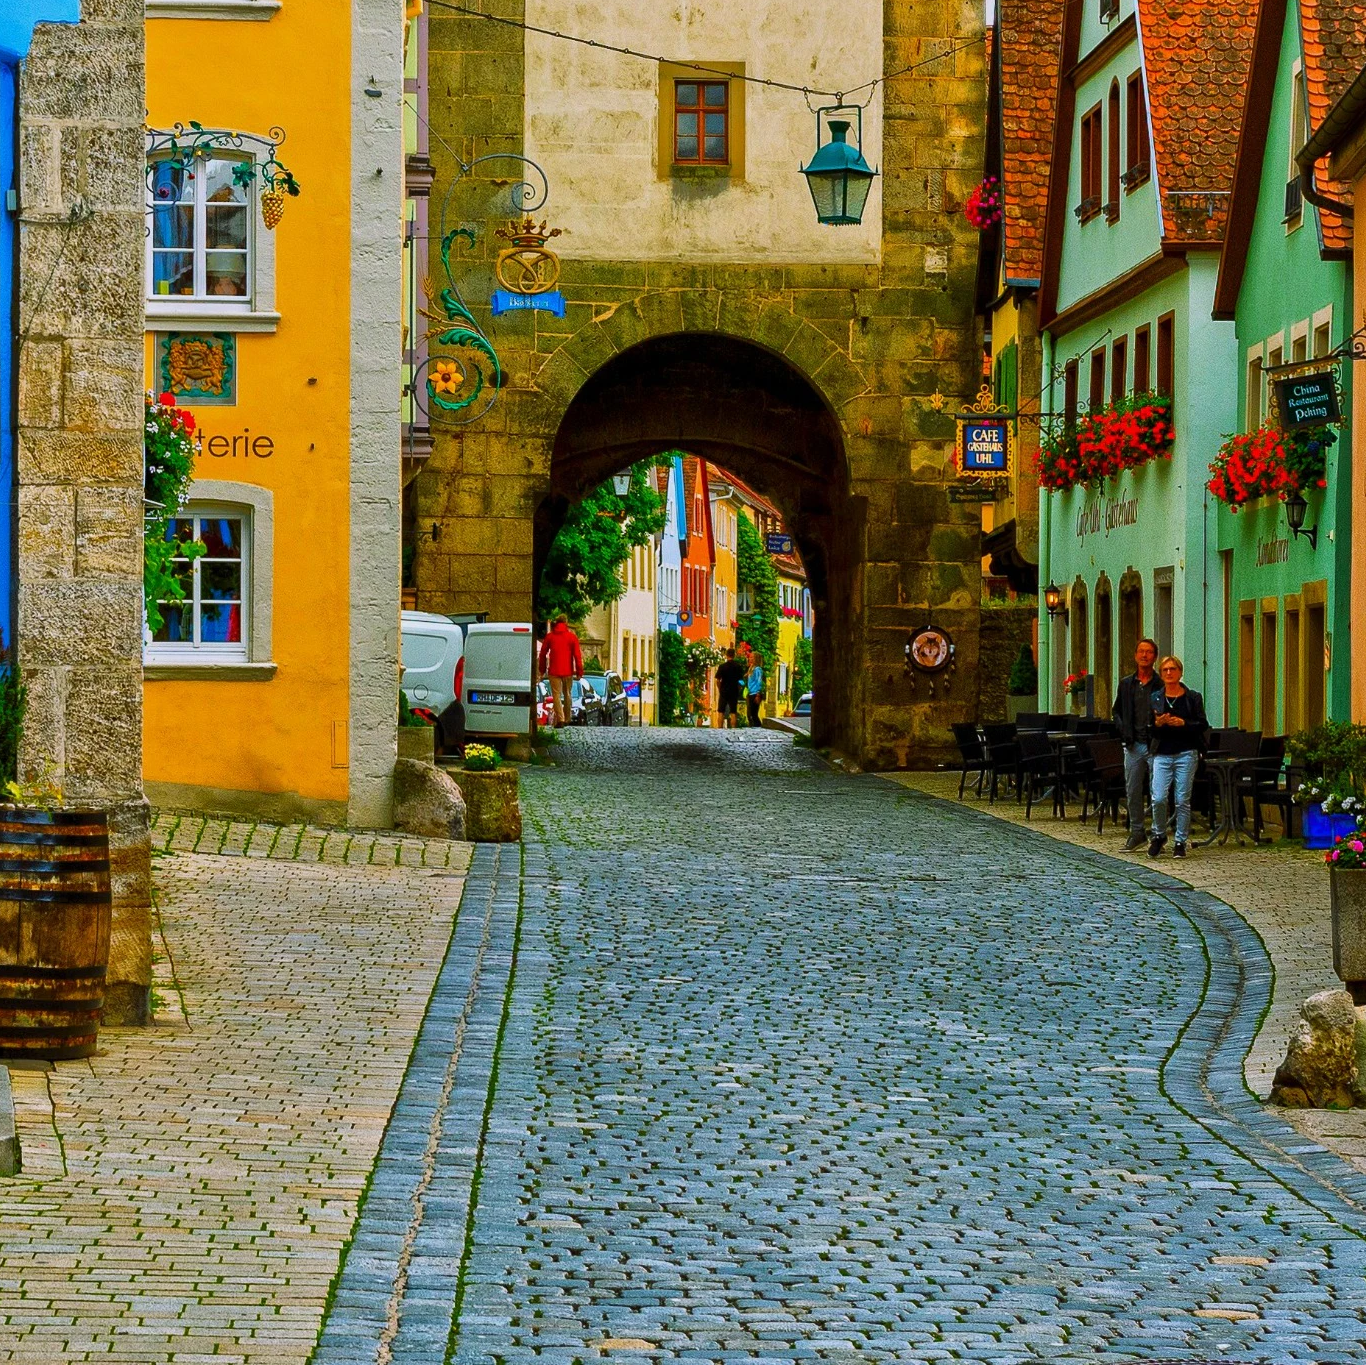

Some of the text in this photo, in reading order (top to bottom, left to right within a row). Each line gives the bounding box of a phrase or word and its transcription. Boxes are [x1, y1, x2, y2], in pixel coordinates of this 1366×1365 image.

[1293, 385, 1321, 396] China
[1288, 393, 1329, 408] Restaurant
[1295, 406, 1328, 422] Peking
[972, 429, 999, 442] CAFE
[195, 428, 274, 458] terie
[975, 453, 995, 464] UHL
